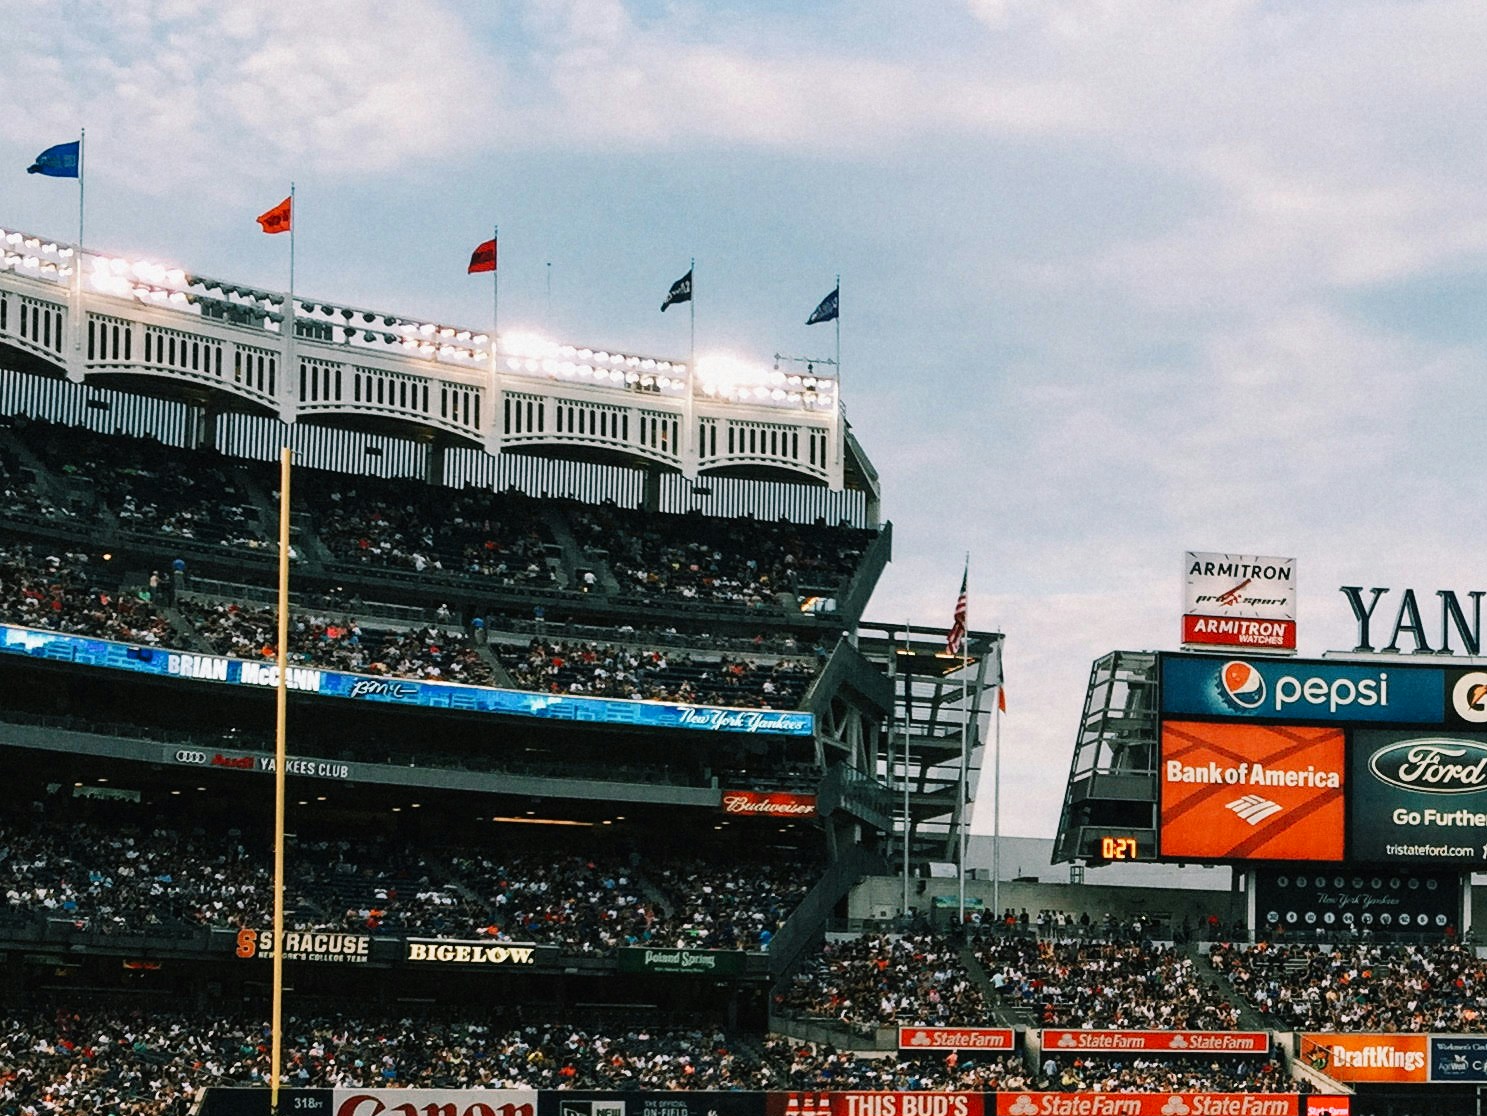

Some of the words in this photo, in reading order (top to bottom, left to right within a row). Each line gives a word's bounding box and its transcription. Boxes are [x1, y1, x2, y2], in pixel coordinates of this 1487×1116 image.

[1190, 562, 1291, 580] ARMITRON
[1194, 619, 1287, 636] ARMITRON
[1239, 634, 1283, 644] WATCHES
[168, 654, 227, 680] BRIAN
[1275, 673, 1389, 712] pepsi
[677, 707, 709, 723] New
[710, 710, 744, 731] York
[746, 712, 806, 732] Yankees
[261, 758, 315, 774] YAKEES
[319, 764, 348, 778] CLUB
[1167, 761, 1222, 784] Bank
[1226, 763, 1249, 785] of
[1250, 764, 1339, 788] America
[724, 796, 815, 814] Budweiser
[1392, 808, 1420, 825] Go
[1103, 839, 1136, 859] 0:27
[1386, 844, 1474, 857] tristateford.com
[1334, 1046, 1424, 1071] DraftKings
[845, 1096, 895, 1116] THIS
